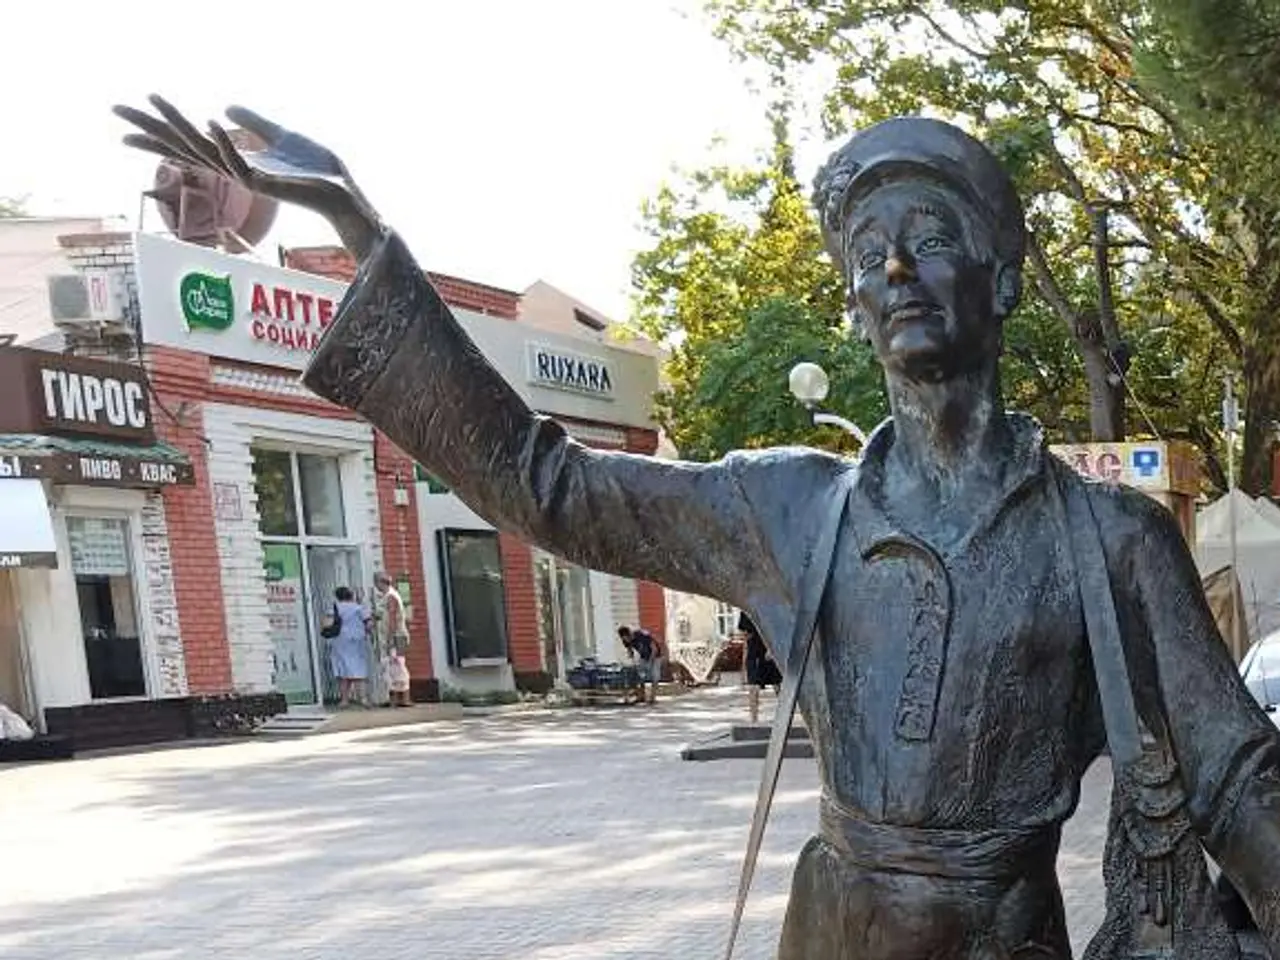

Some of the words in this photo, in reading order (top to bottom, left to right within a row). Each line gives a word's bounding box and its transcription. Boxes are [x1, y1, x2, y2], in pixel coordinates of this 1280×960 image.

[252, 284, 333, 328] АПТЕ
[252, 320, 320, 350] СОЦИА
[537, 351, 612, 391] RUXARA
[41, 368, 147, 428] ГИРОС
[79, 457, 122, 481] ПИВО
[140, 462, 178, 484] КВАС
